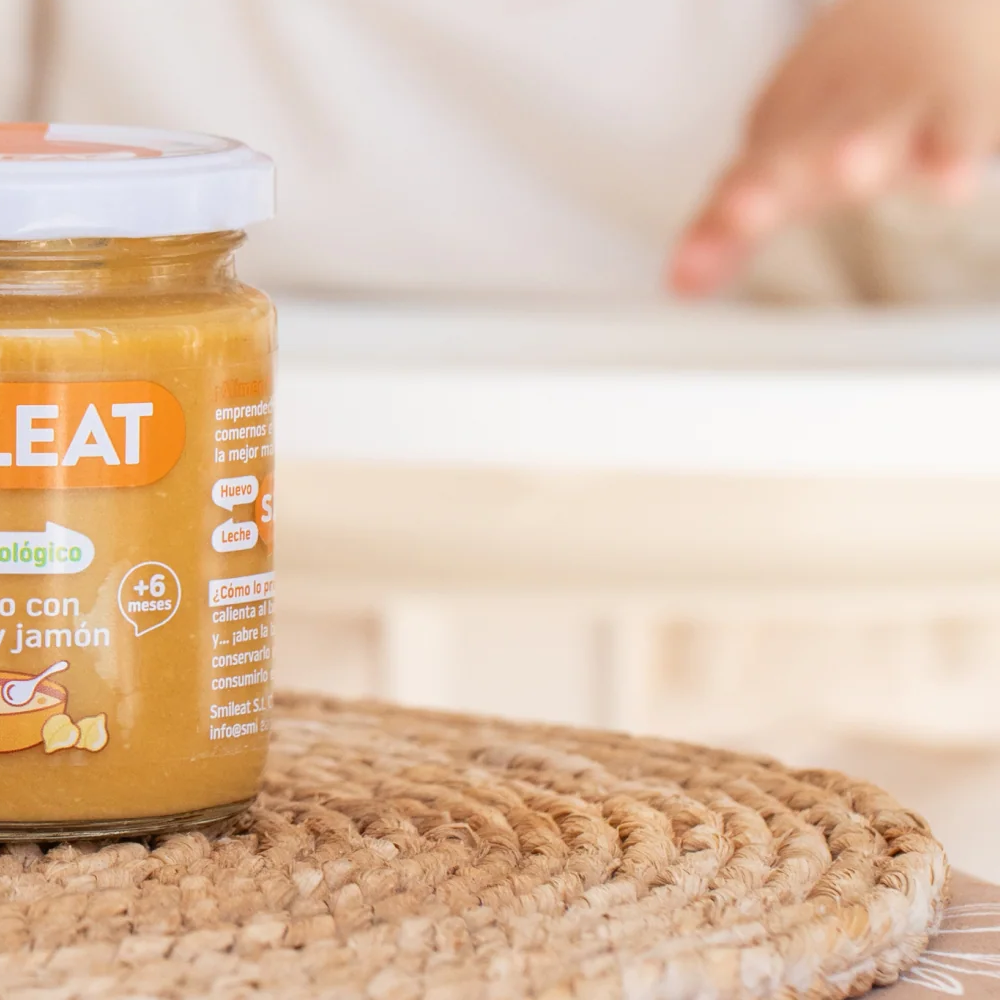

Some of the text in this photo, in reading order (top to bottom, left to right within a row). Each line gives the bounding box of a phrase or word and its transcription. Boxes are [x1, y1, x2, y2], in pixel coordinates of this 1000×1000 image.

[215, 424, 266, 442] comernos
[215, 447, 225, 463] la
[228, 444, 259, 464] mejor
[220, 484, 252, 497] Huevo
[221, 527, 251, 543] Leche
[133, 574, 166, 597] +6
[213, 582, 250, 603] ¿Cómo
[253, 580, 262, 594] lo
[26, 596, 80, 617] con
[127, 599, 172, 613] meses
[212, 605, 256, 623] calienta
[258, 600, 267, 617] al
[11, 621, 110, 654] jamón
[212, 633, 230, 650] y...
[260, 624, 268, 638] la
[211, 645, 270, 668] conservarlo
[211, 668, 268, 690] consumirlo
[210, 700, 251, 719] Smileat
